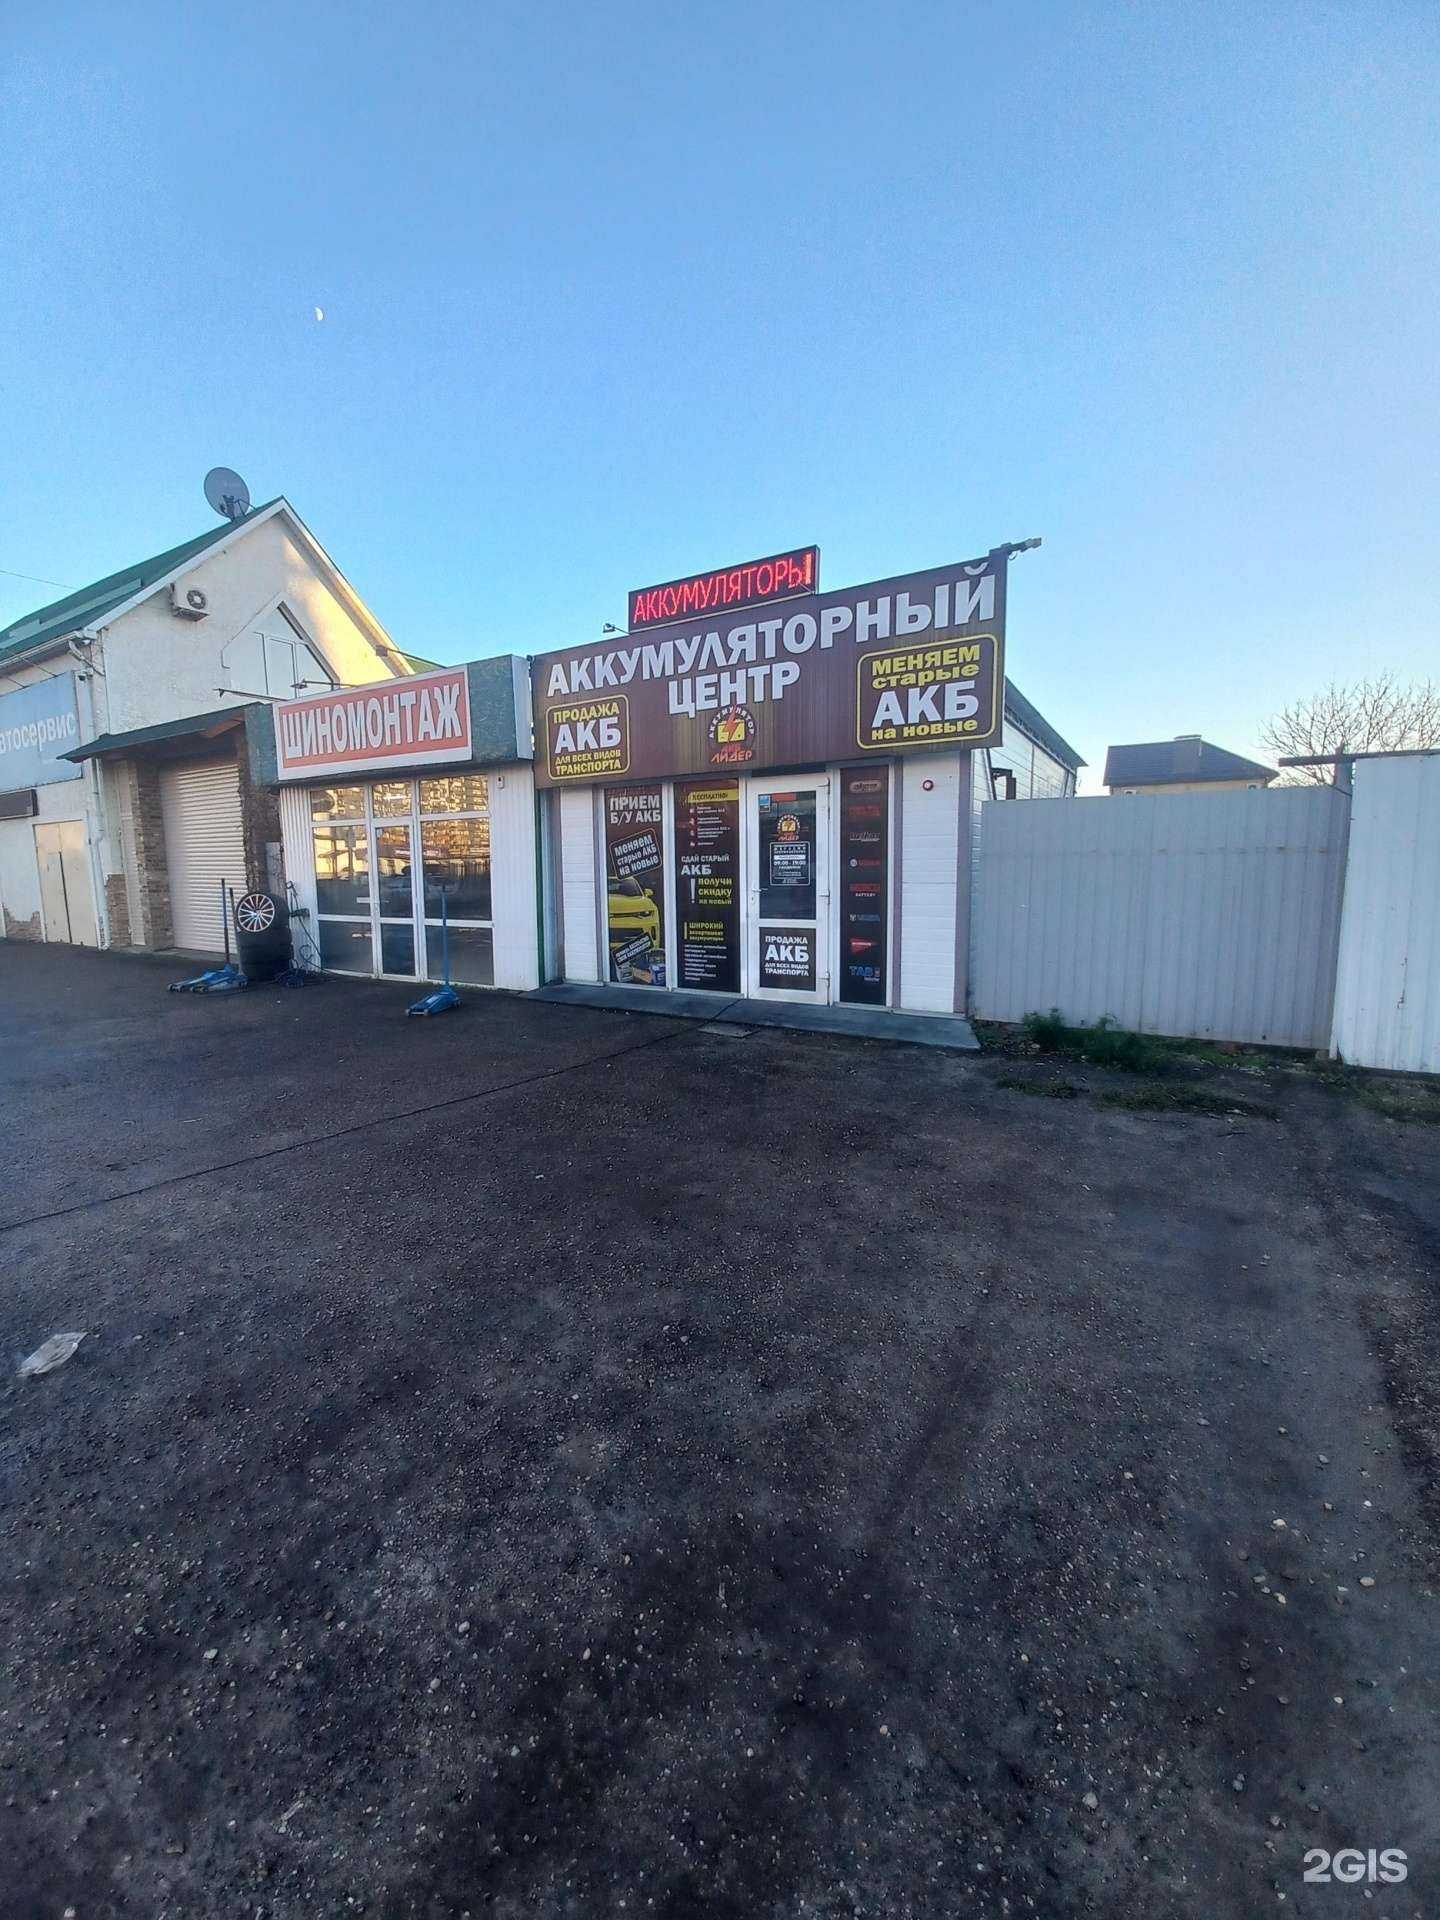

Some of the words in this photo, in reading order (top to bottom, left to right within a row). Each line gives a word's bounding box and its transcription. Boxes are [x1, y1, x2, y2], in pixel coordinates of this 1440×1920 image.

[633, 553, 813, 624] АККУМУЛЯТОРЫ
[546, 562, 996, 697] АККУМУЛЯТОРНЫЙ
[872, 644, 980, 676] МЕНЯЕМ
[872, 663, 980, 689] старые
[668, 661, 801, 718] ЦЕНТР
[553, 702, 620, 724] ПРОДАЖА
[871, 680, 979, 728] АКБ
[0, 711, 77, 754] втосервис
[281, 682, 463, 759] ШИНОМОНТАЖ
[871, 728, 897, 740] на
[903, 719, 978, 737] новые
[554, 716, 621, 754] АКБ
[555, 756, 571, 765] ДЛЯ
[572, 752, 592, 763] ВСЕХ
[556, 759, 622, 776] ТРАНСПОРТА
[609, 794, 660, 811] ПРИЕМ
[610, 811, 633, 826] Б/У
[635, 810, 661, 823] АКБ
[681, 864, 712, 875] АКБ
[765, 936, 808, 944] ПРОДАЖА
[765, 945, 809, 962] АКБ
